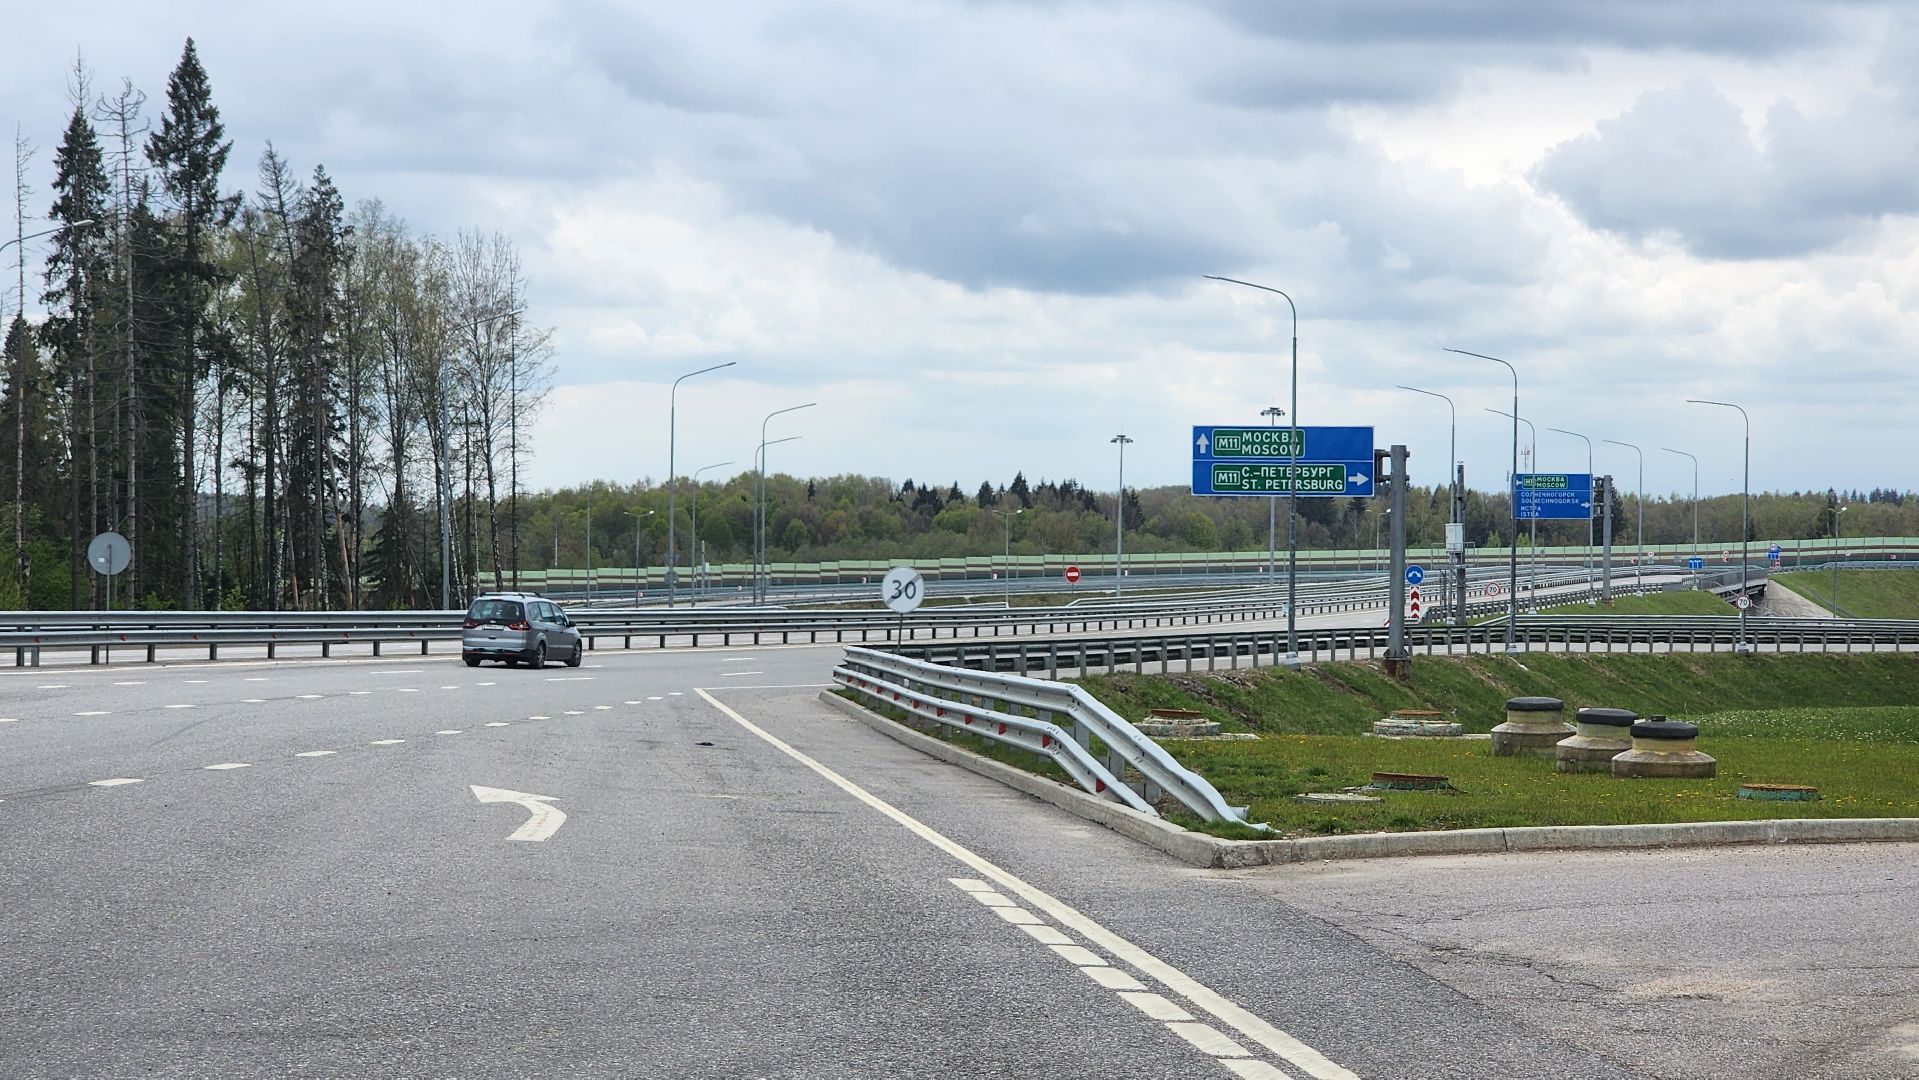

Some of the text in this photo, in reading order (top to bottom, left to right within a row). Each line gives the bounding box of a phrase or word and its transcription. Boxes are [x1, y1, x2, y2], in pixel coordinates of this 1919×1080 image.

[1241, 444, 1301, 455] MOSCOW
[1241, 466, 1334, 477] С.-ПЕТЕРБУРГ
[1241, 479, 1261, 490] ST.
[891, 580, 916, 599] 30
